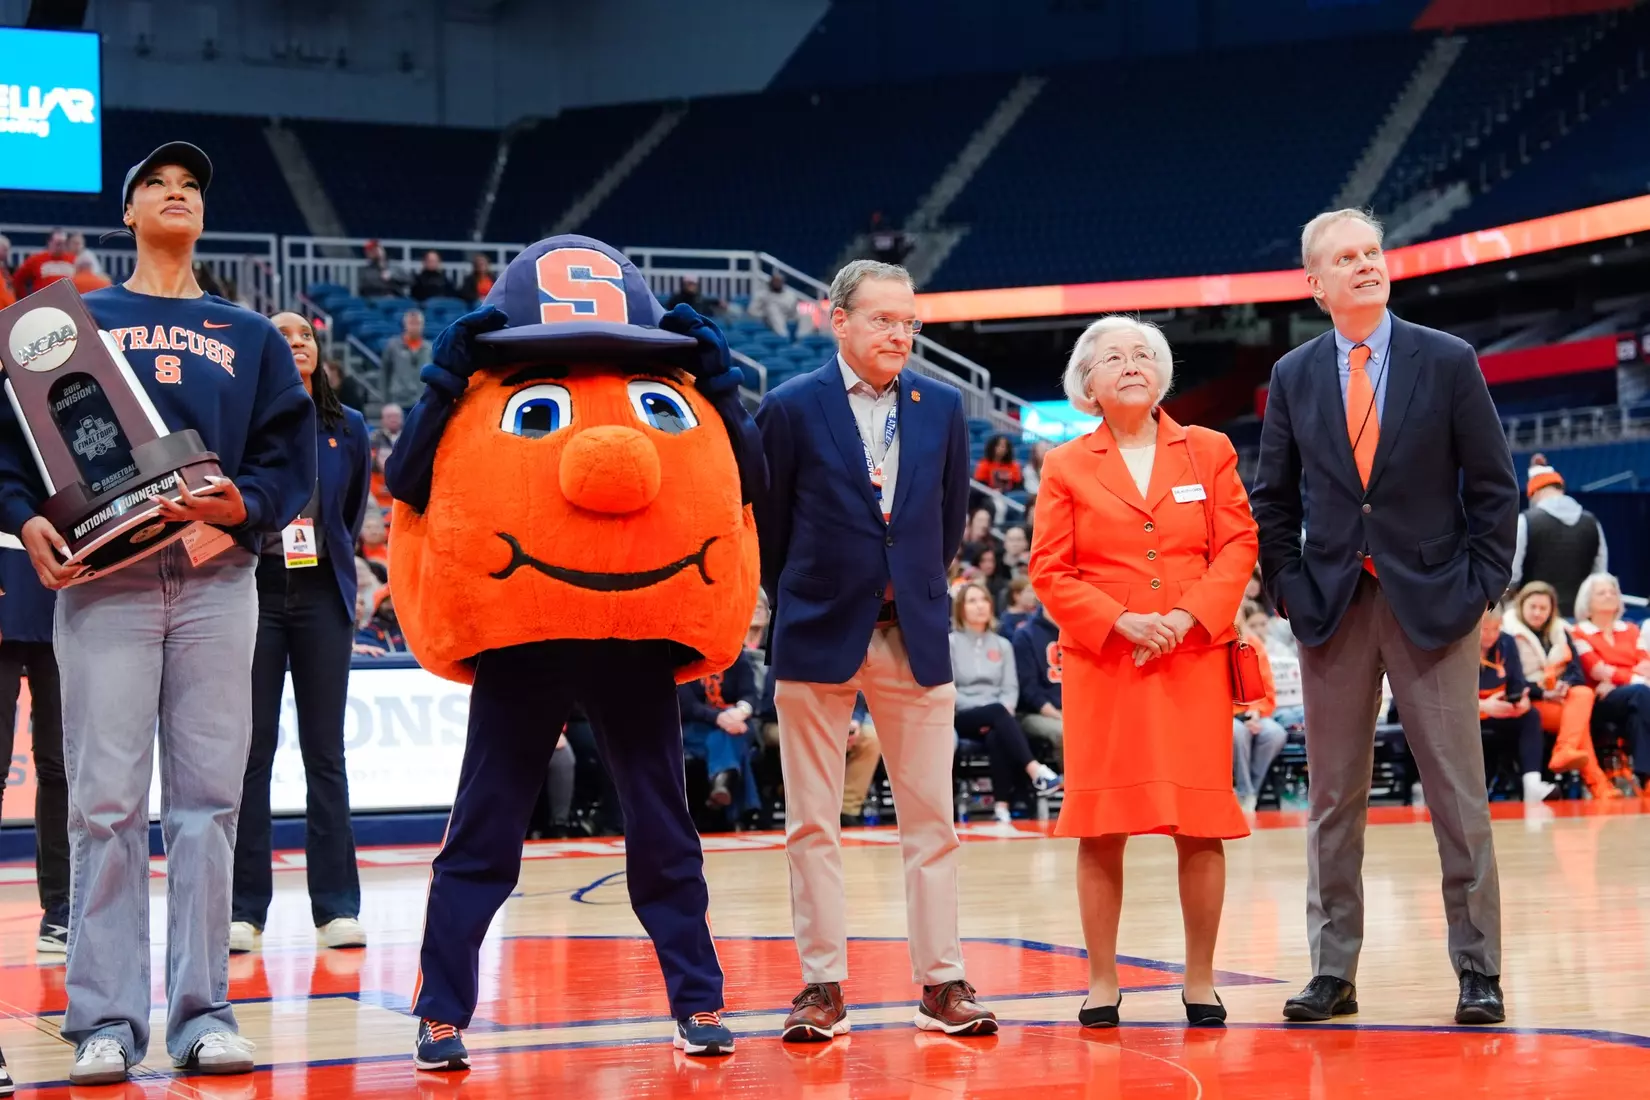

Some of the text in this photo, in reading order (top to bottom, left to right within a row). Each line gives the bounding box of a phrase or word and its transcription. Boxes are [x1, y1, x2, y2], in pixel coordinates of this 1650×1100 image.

[535, 247, 628, 325] S
[18, 324, 76, 365] NCAA
[155, 354, 182, 384] S
[56, 386, 92, 412] DIVISION
[63, 381, 81, 397] 2016
[77, 426, 114, 451] FINAL FOUR
[74, 504, 118, 540] NATIONAL
